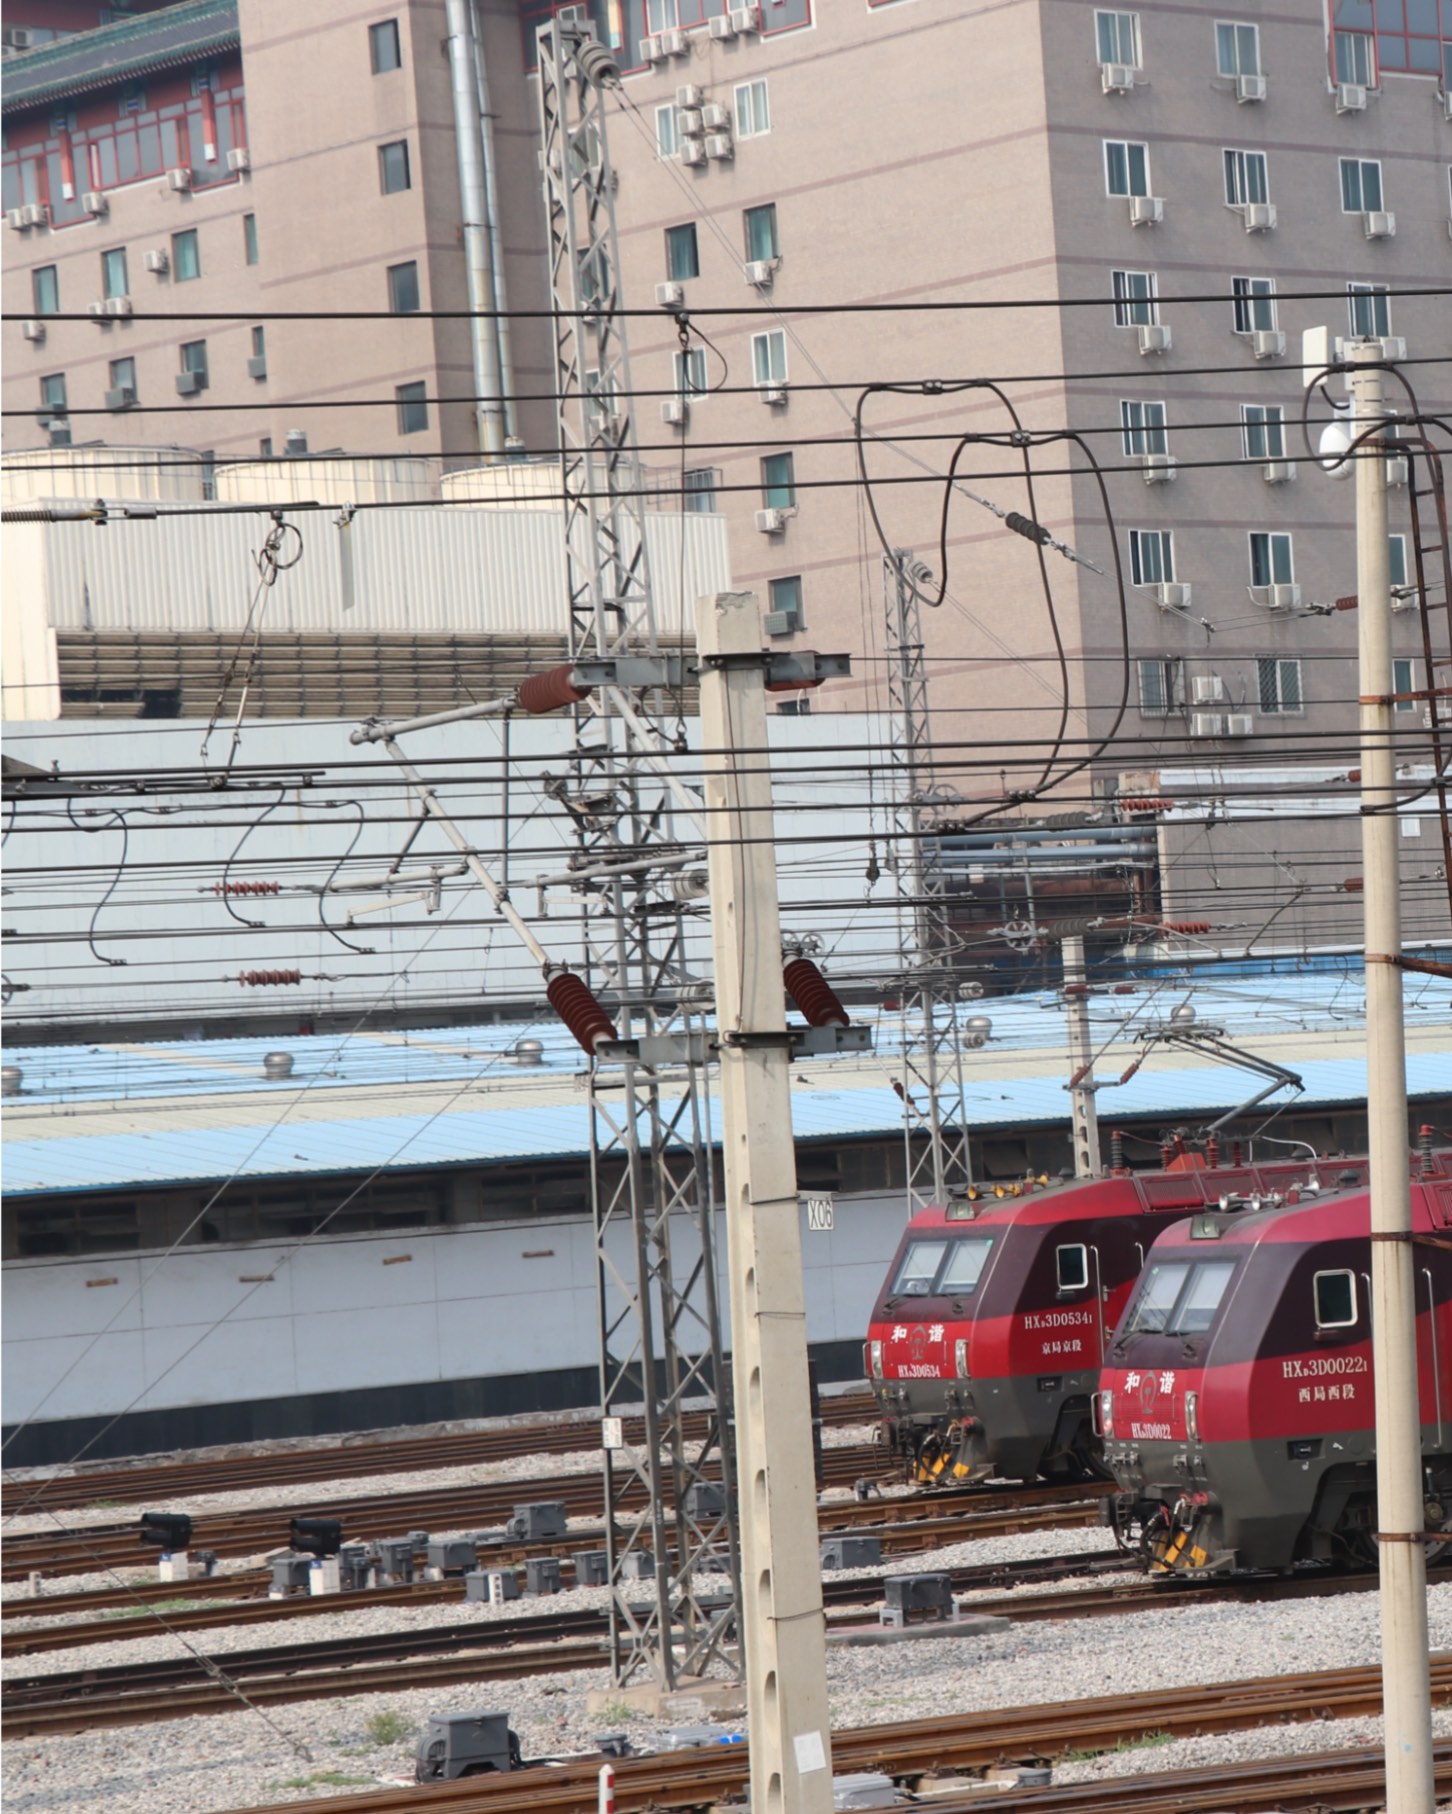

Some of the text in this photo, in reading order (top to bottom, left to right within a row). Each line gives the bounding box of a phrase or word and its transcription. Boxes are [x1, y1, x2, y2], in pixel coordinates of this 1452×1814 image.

[809, 1200, 833, 1228] X06
[890, 1323, 944, 1343] 和 谐
[1042, 1339, 1082, 1355] 京局京段
[1124, 1370, 1176, 1394] 和 谐
[1298, 1383, 1355, 1403] 西局西段
